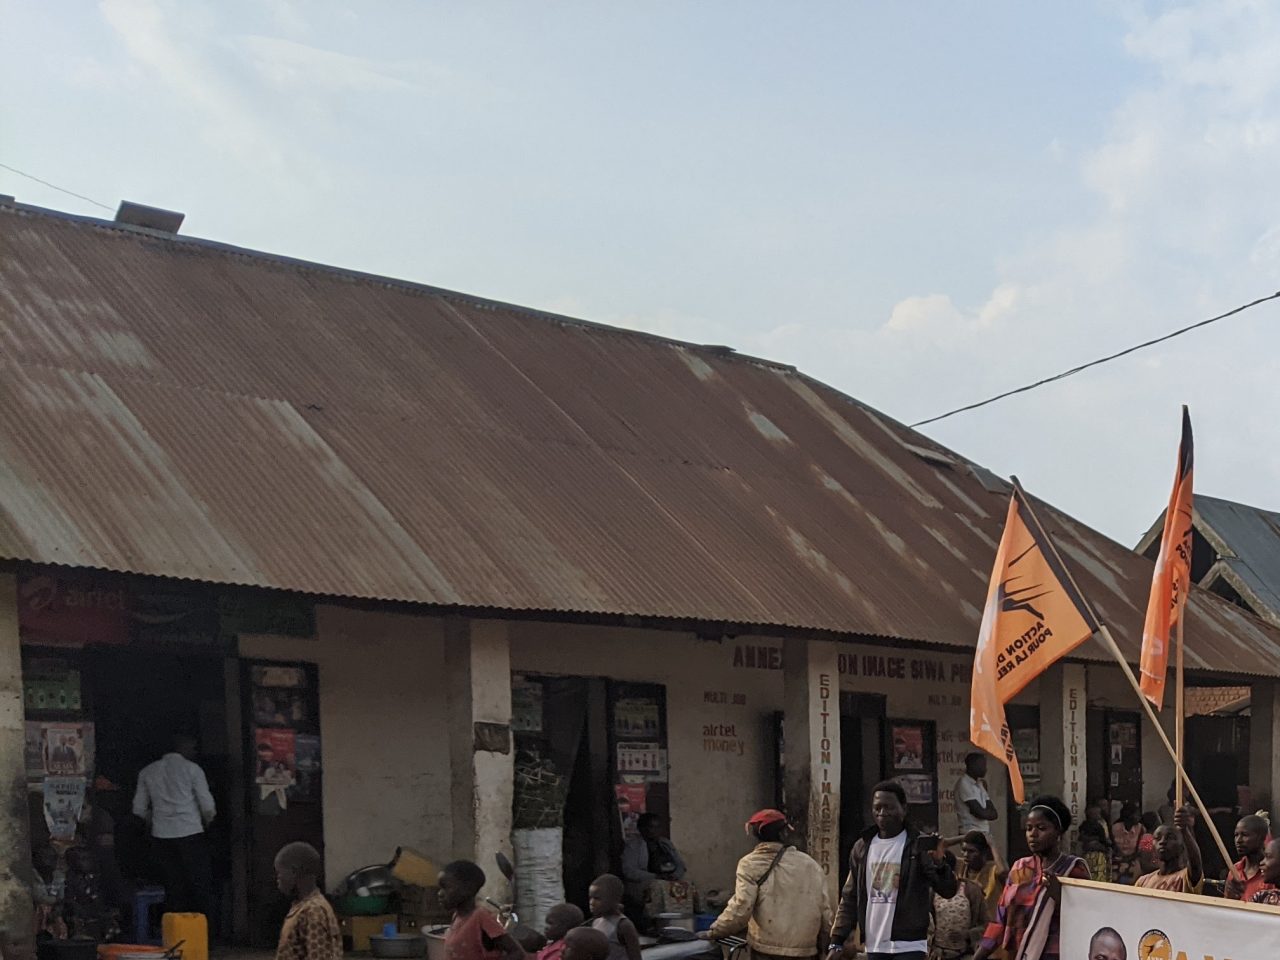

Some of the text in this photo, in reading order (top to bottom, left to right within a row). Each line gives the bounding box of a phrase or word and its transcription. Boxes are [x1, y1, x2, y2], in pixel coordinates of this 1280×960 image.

[733, 645, 784, 669] ANNE
[862, 655, 905, 679] IMAGE
[702, 723, 738, 737] airtel
[1069, 687, 1078, 767] EDITION
[703, 738, 745, 757] money
[819, 673, 832, 877] EDITION IMAGE PRO
